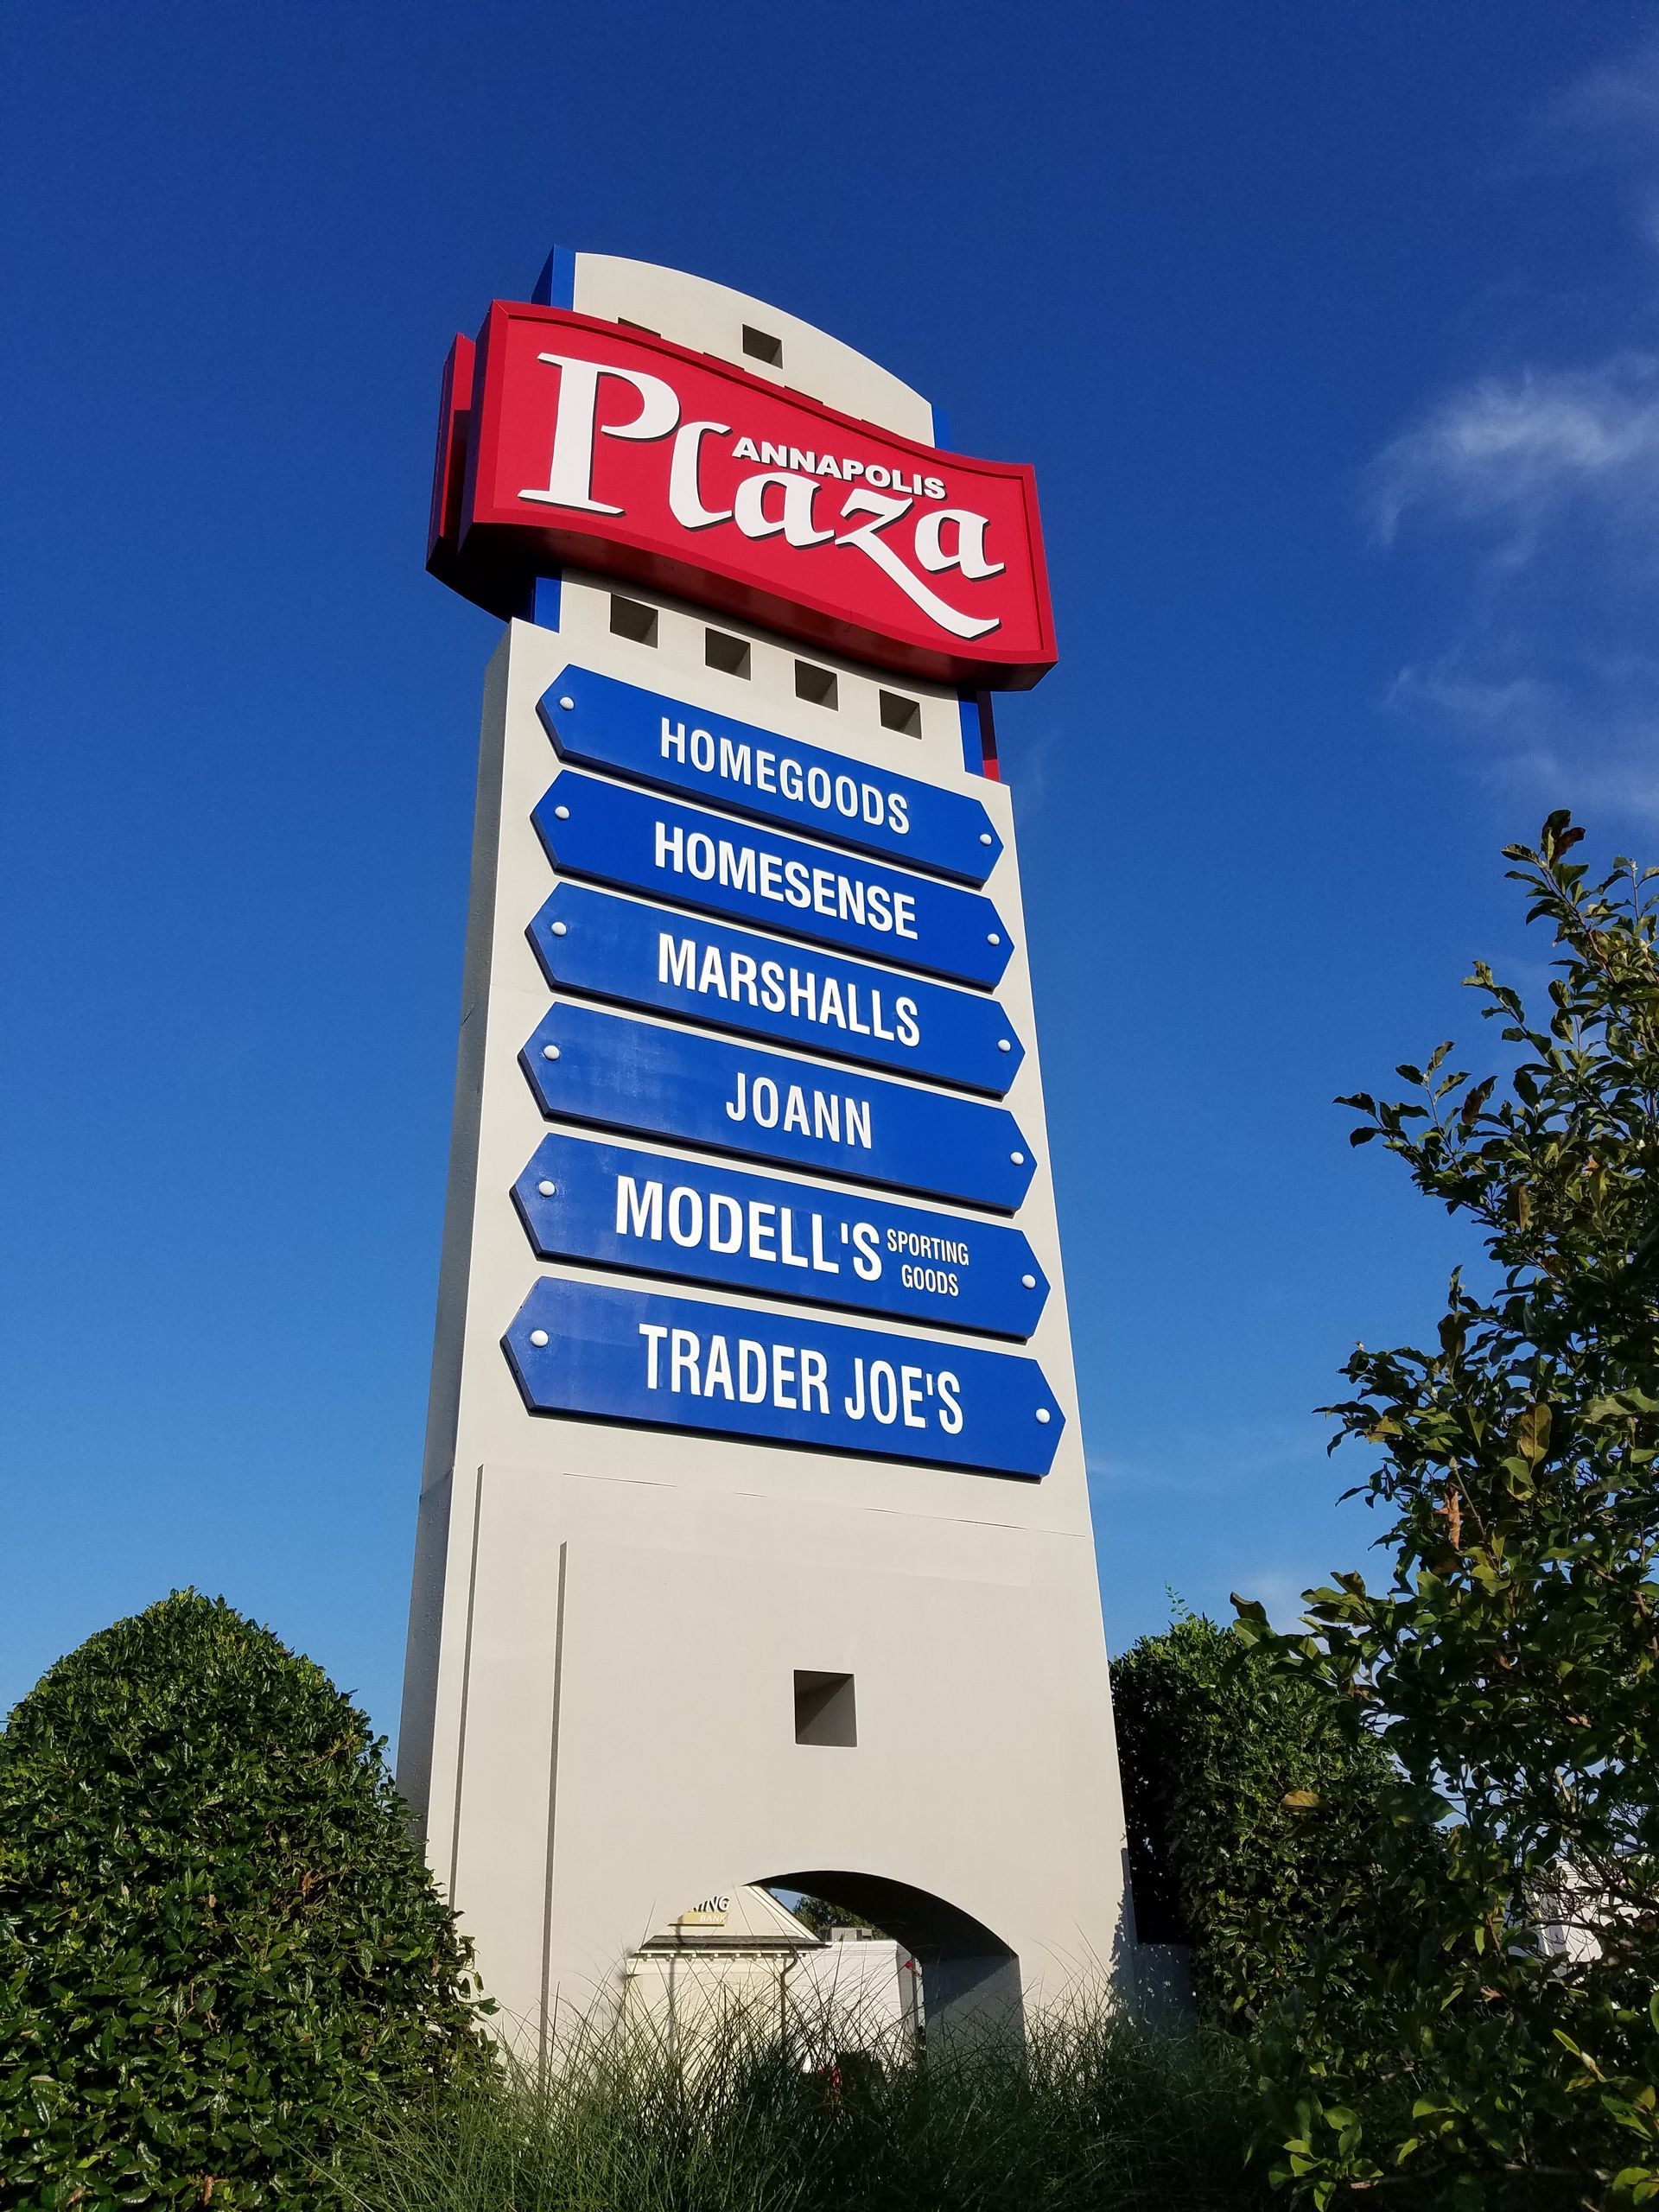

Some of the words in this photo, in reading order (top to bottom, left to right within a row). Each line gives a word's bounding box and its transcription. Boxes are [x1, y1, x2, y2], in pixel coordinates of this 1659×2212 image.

[518, 352, 1005, 640] Plaza
[731, 436, 947, 500] ANNAPOLIS
[660, 717, 911, 835] HOMEGOODS
[654, 821, 919, 940] HOMESENSE
[658, 932, 921, 1047] MARSHALLS
[726, 1071, 873, 1149] JOANN
[614, 1174, 883, 1282] MODELL'S
[886, 1228, 970, 1267] SPORTING
[900, 1264, 960, 1298] GOODS
[638, 1322, 830, 1415] TRADER
[843, 1357, 964, 1435] JOE'S
[700, 1914, 727, 1923] BANK
